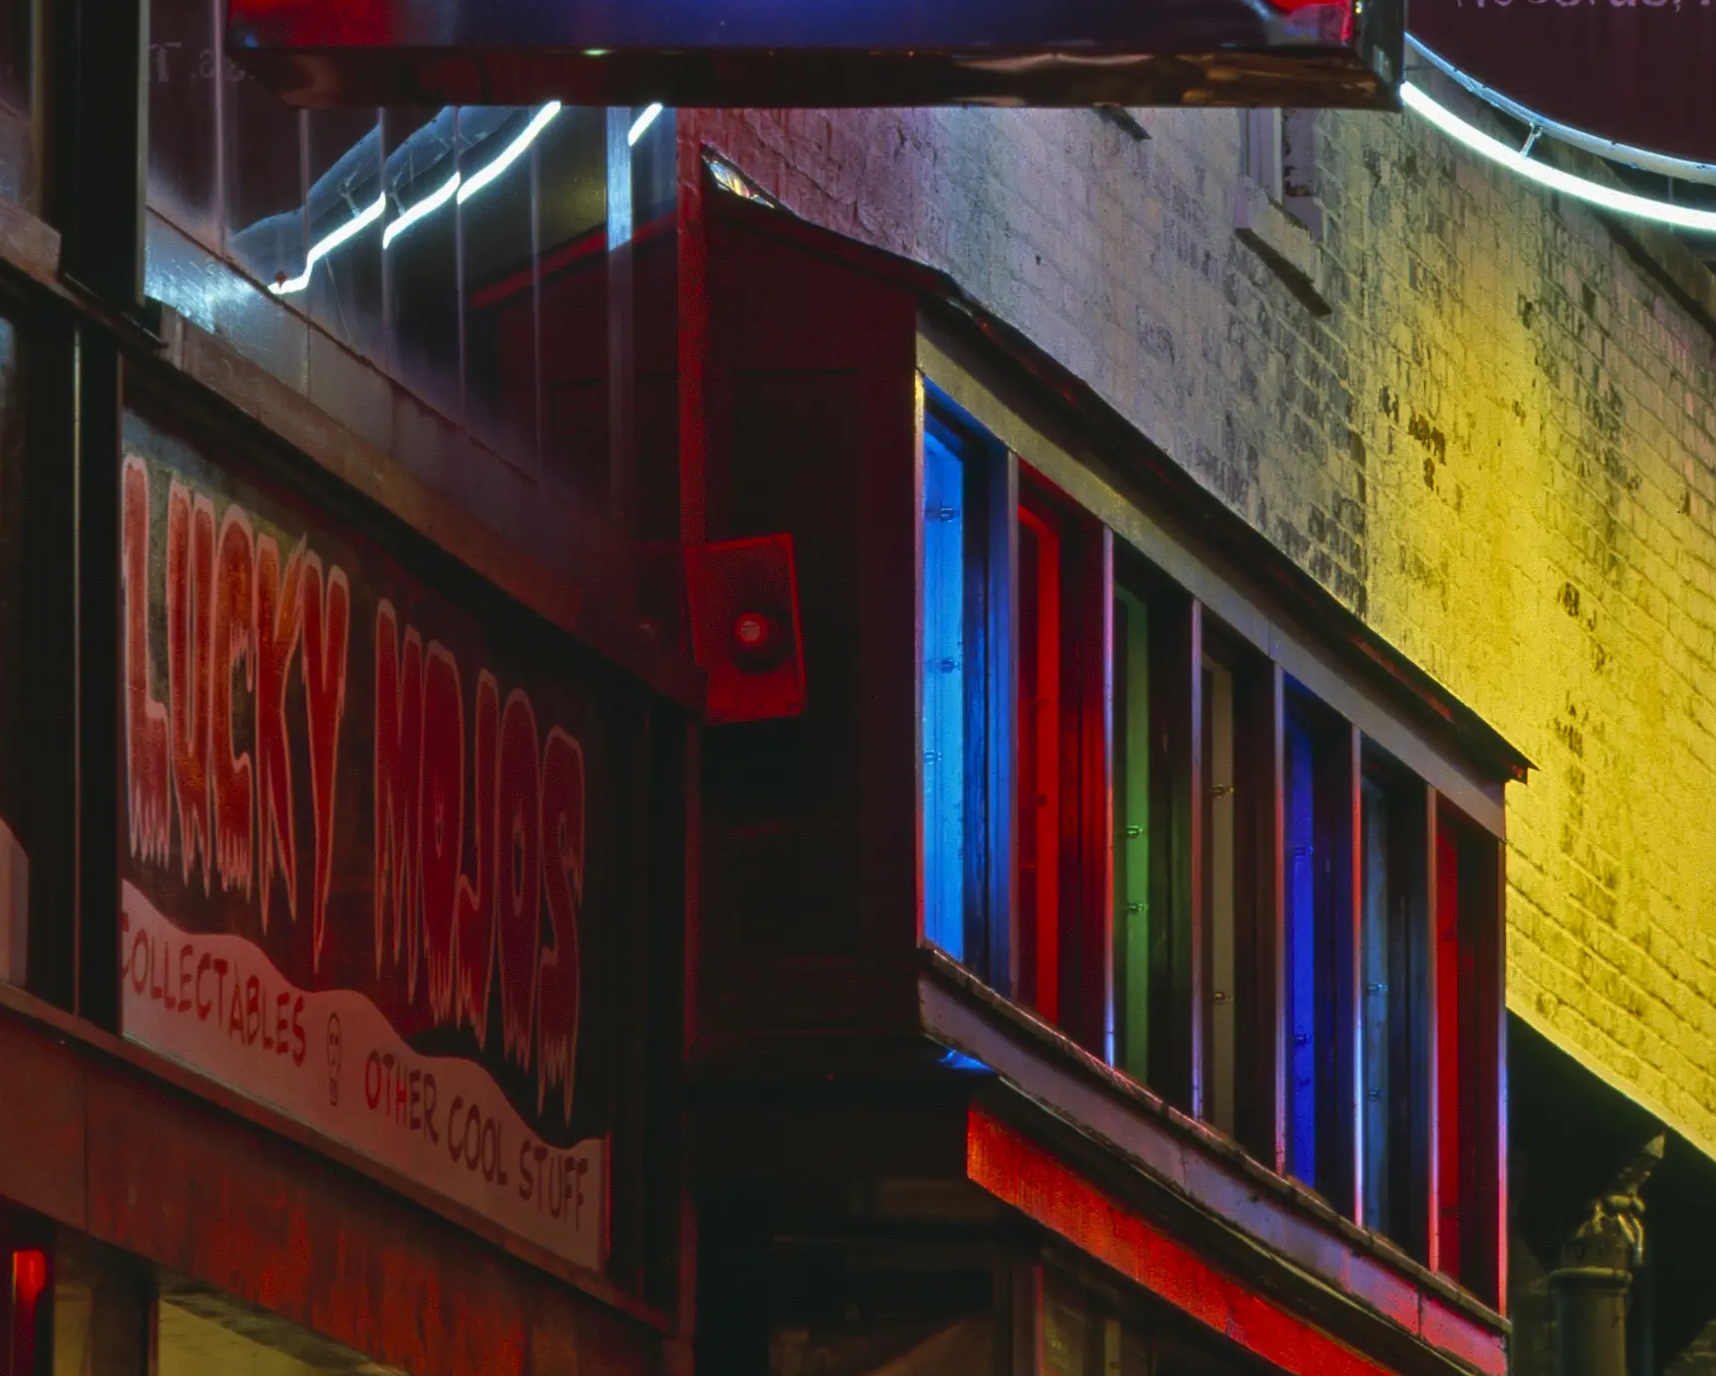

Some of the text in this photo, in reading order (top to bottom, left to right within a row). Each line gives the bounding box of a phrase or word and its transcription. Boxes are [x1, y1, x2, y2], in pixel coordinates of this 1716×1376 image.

[123, 454, 350, 975] LUCKY
[364, 1050, 439, 1146] OTHER
[447, 1095, 508, 1186] COOL
[518, 1139, 589, 1232] STUFF
